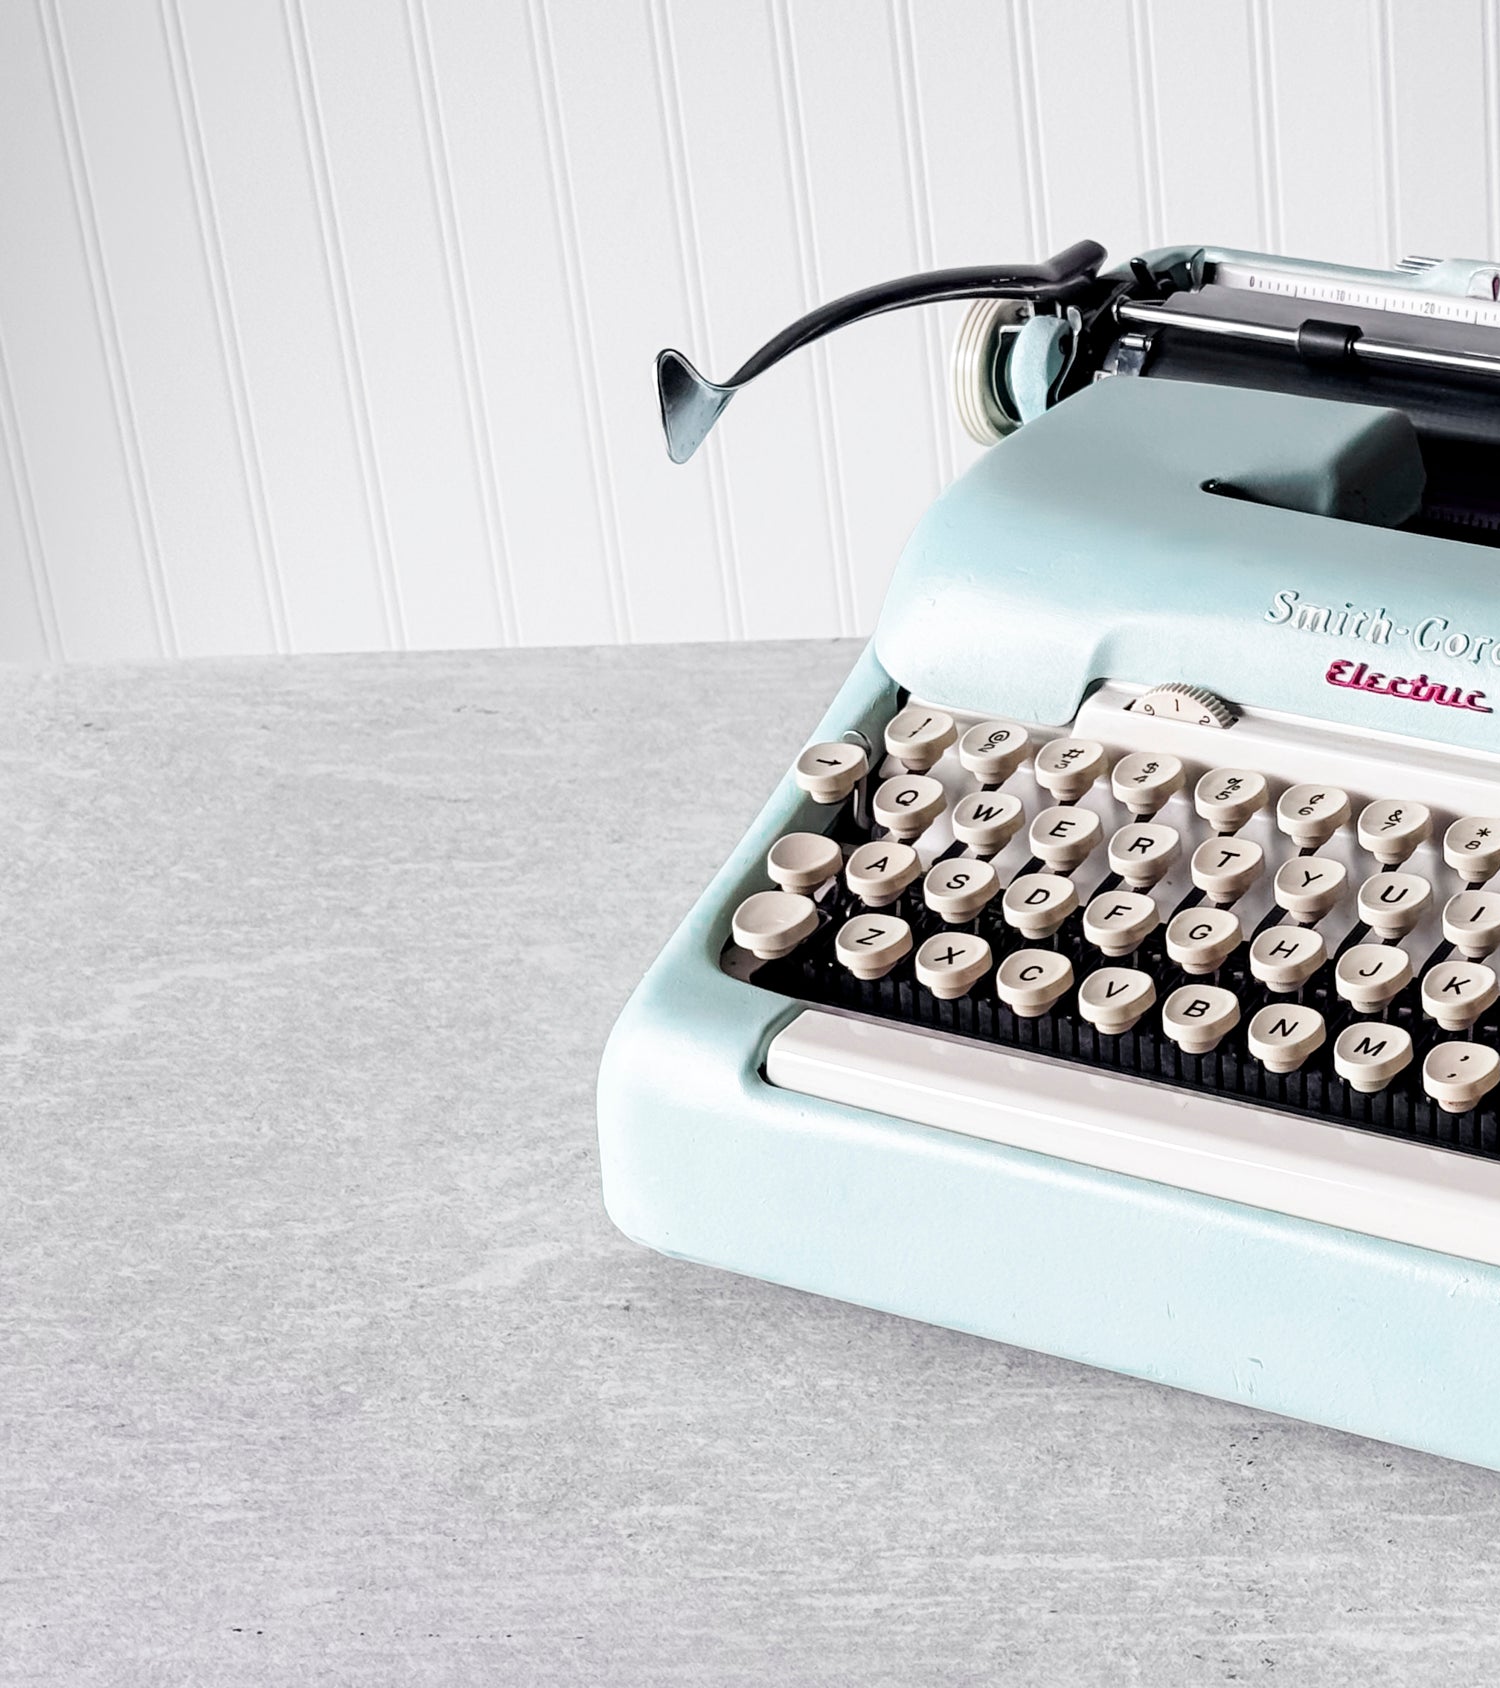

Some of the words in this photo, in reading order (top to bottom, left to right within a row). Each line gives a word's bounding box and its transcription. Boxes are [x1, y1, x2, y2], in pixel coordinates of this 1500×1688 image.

[1423, 301, 1435, 315] 20
[1325, 659, 1494, 714] Electric
[988, 729, 1011, 744] @
[1061, 748, 1085, 759] #
[1141, 761, 1159, 775] $
[1225, 777, 1244, 791] %
[895, 789, 918, 807] Q
[1214, 790, 1232, 801] 5
[971, 803, 1004, 822] W
[1298, 806, 1314, 816] 6
[1388, 810, 1403, 823] &
[1048, 820, 1076, 838] E
[1380, 821, 1397, 832] 7
[1127, 836, 1155, 855] R
[1464, 840, 1482, 850] 8
[864, 856, 889, 873] A
[1216, 850, 1241, 868] T
[945, 873, 971, 890] S
[1301, 870, 1324, 888] Y
[1023, 888, 1050, 905] D
[1379, 884, 1409, 904] U
[1103, 904, 1133, 921] F
[1469, 906, 1486, 923] I
[855, 927, 886, 946] Z
[1188, 923, 1213, 941] G
[933, 946, 966, 965] X
[1269, 939, 1300, 959] H
[1018, 965, 1044, 982] C
[1358, 961, 1383, 977] J
[1105, 980, 1130, 999] V
[1443, 976, 1471, 995] K
[1182, 999, 1211, 1018] B
[1268, 1018, 1299, 1038] N
[1353, 1036, 1388, 1057] M
